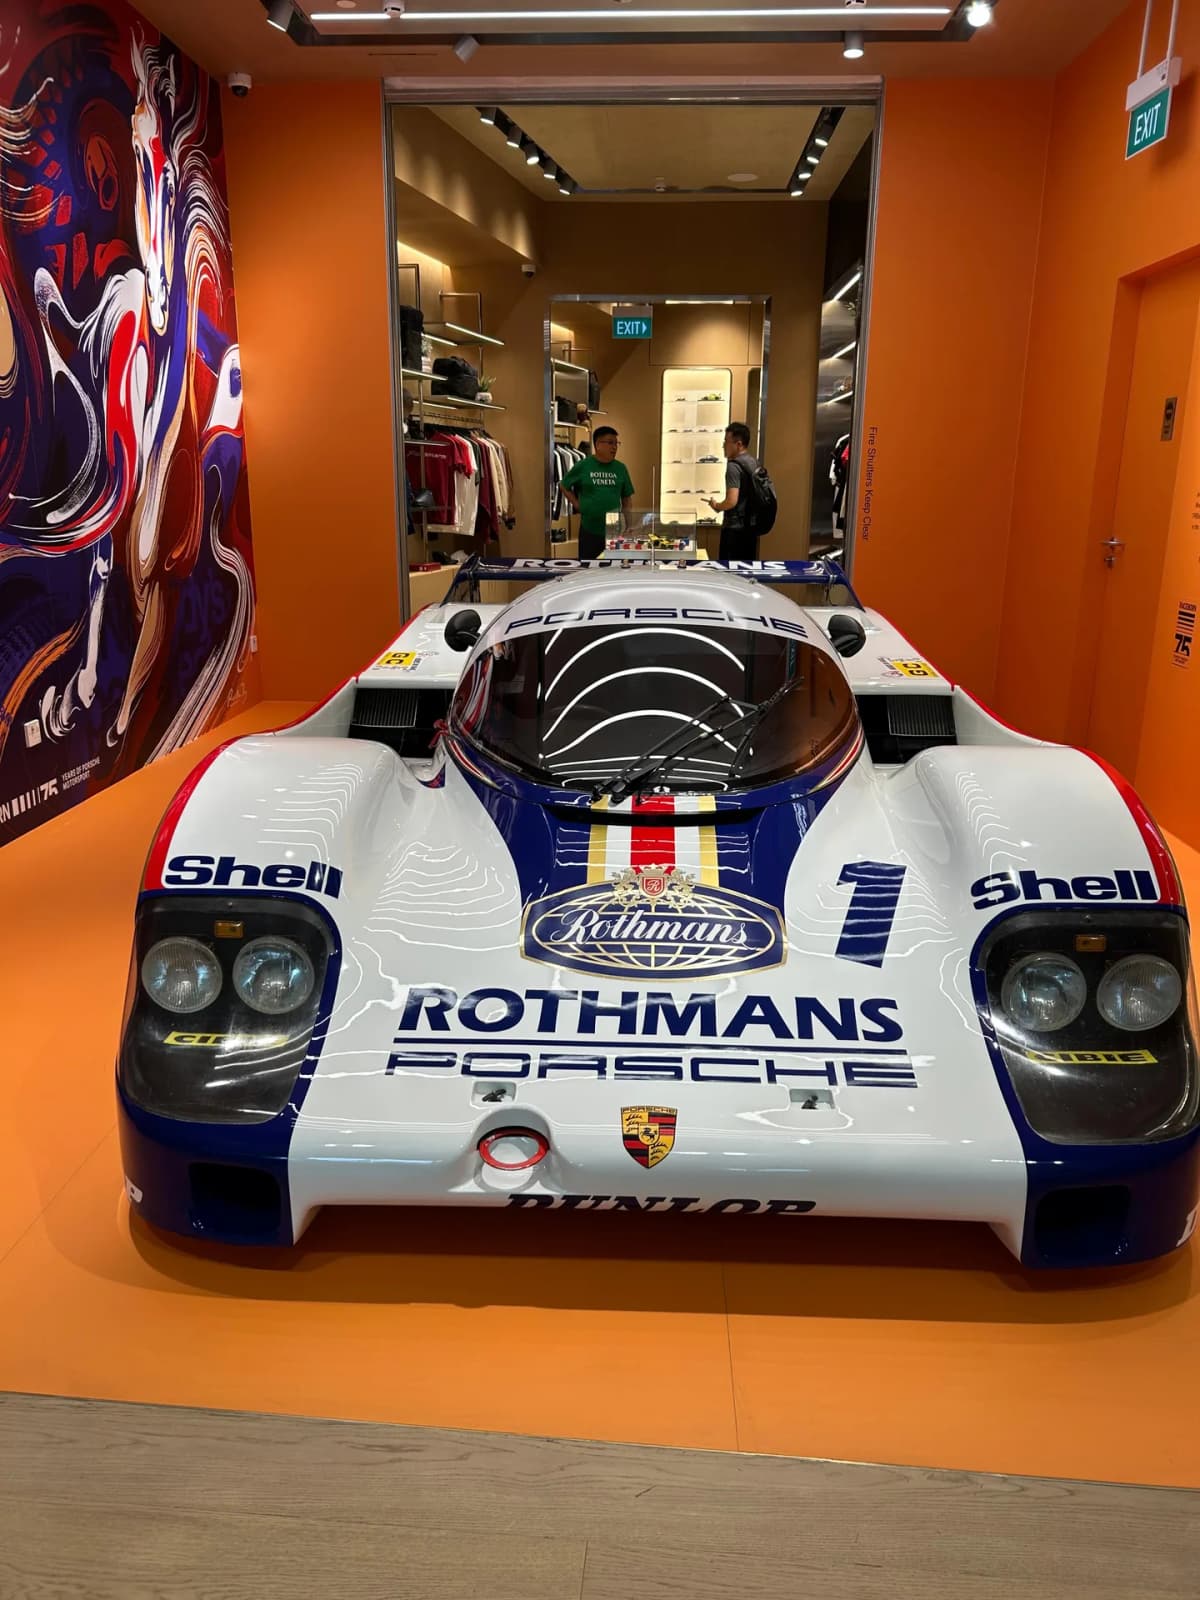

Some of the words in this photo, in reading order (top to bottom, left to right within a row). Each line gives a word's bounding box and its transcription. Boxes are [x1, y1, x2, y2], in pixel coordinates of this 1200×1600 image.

[1133, 102, 1161, 146] EXIT
[616, 320, 641, 335] EXIT
[868, 426, 878, 445] Fire
[590, 471, 617, 479] BOTTEGA
[592, 478, 616, 486] VENETA
[865, 447, 876, 487] Shutters
[863, 489, 874, 514] Keep
[862, 516, 872, 541] Clear
[504, 607, 808, 638] PORSCHE
[1175, 633, 1192, 656] 75
[40, 778, 59, 801] 75
[62, 768, 76, 781] YEARS
[82, 756, 100, 772] PORSCHE
[62, 770, 90, 790] MOTORSPORT
[165, 855, 343, 899] Shell
[971, 870, 1158, 910] Shell
[551, 909, 758, 951] Rothmans
[836, 861, 907, 968] 1
[399, 987, 904, 1042] ROTHMANS
[384, 1050, 918, 1088] PORSCHE
[504, 1193, 817, 1216] DUNLOP
